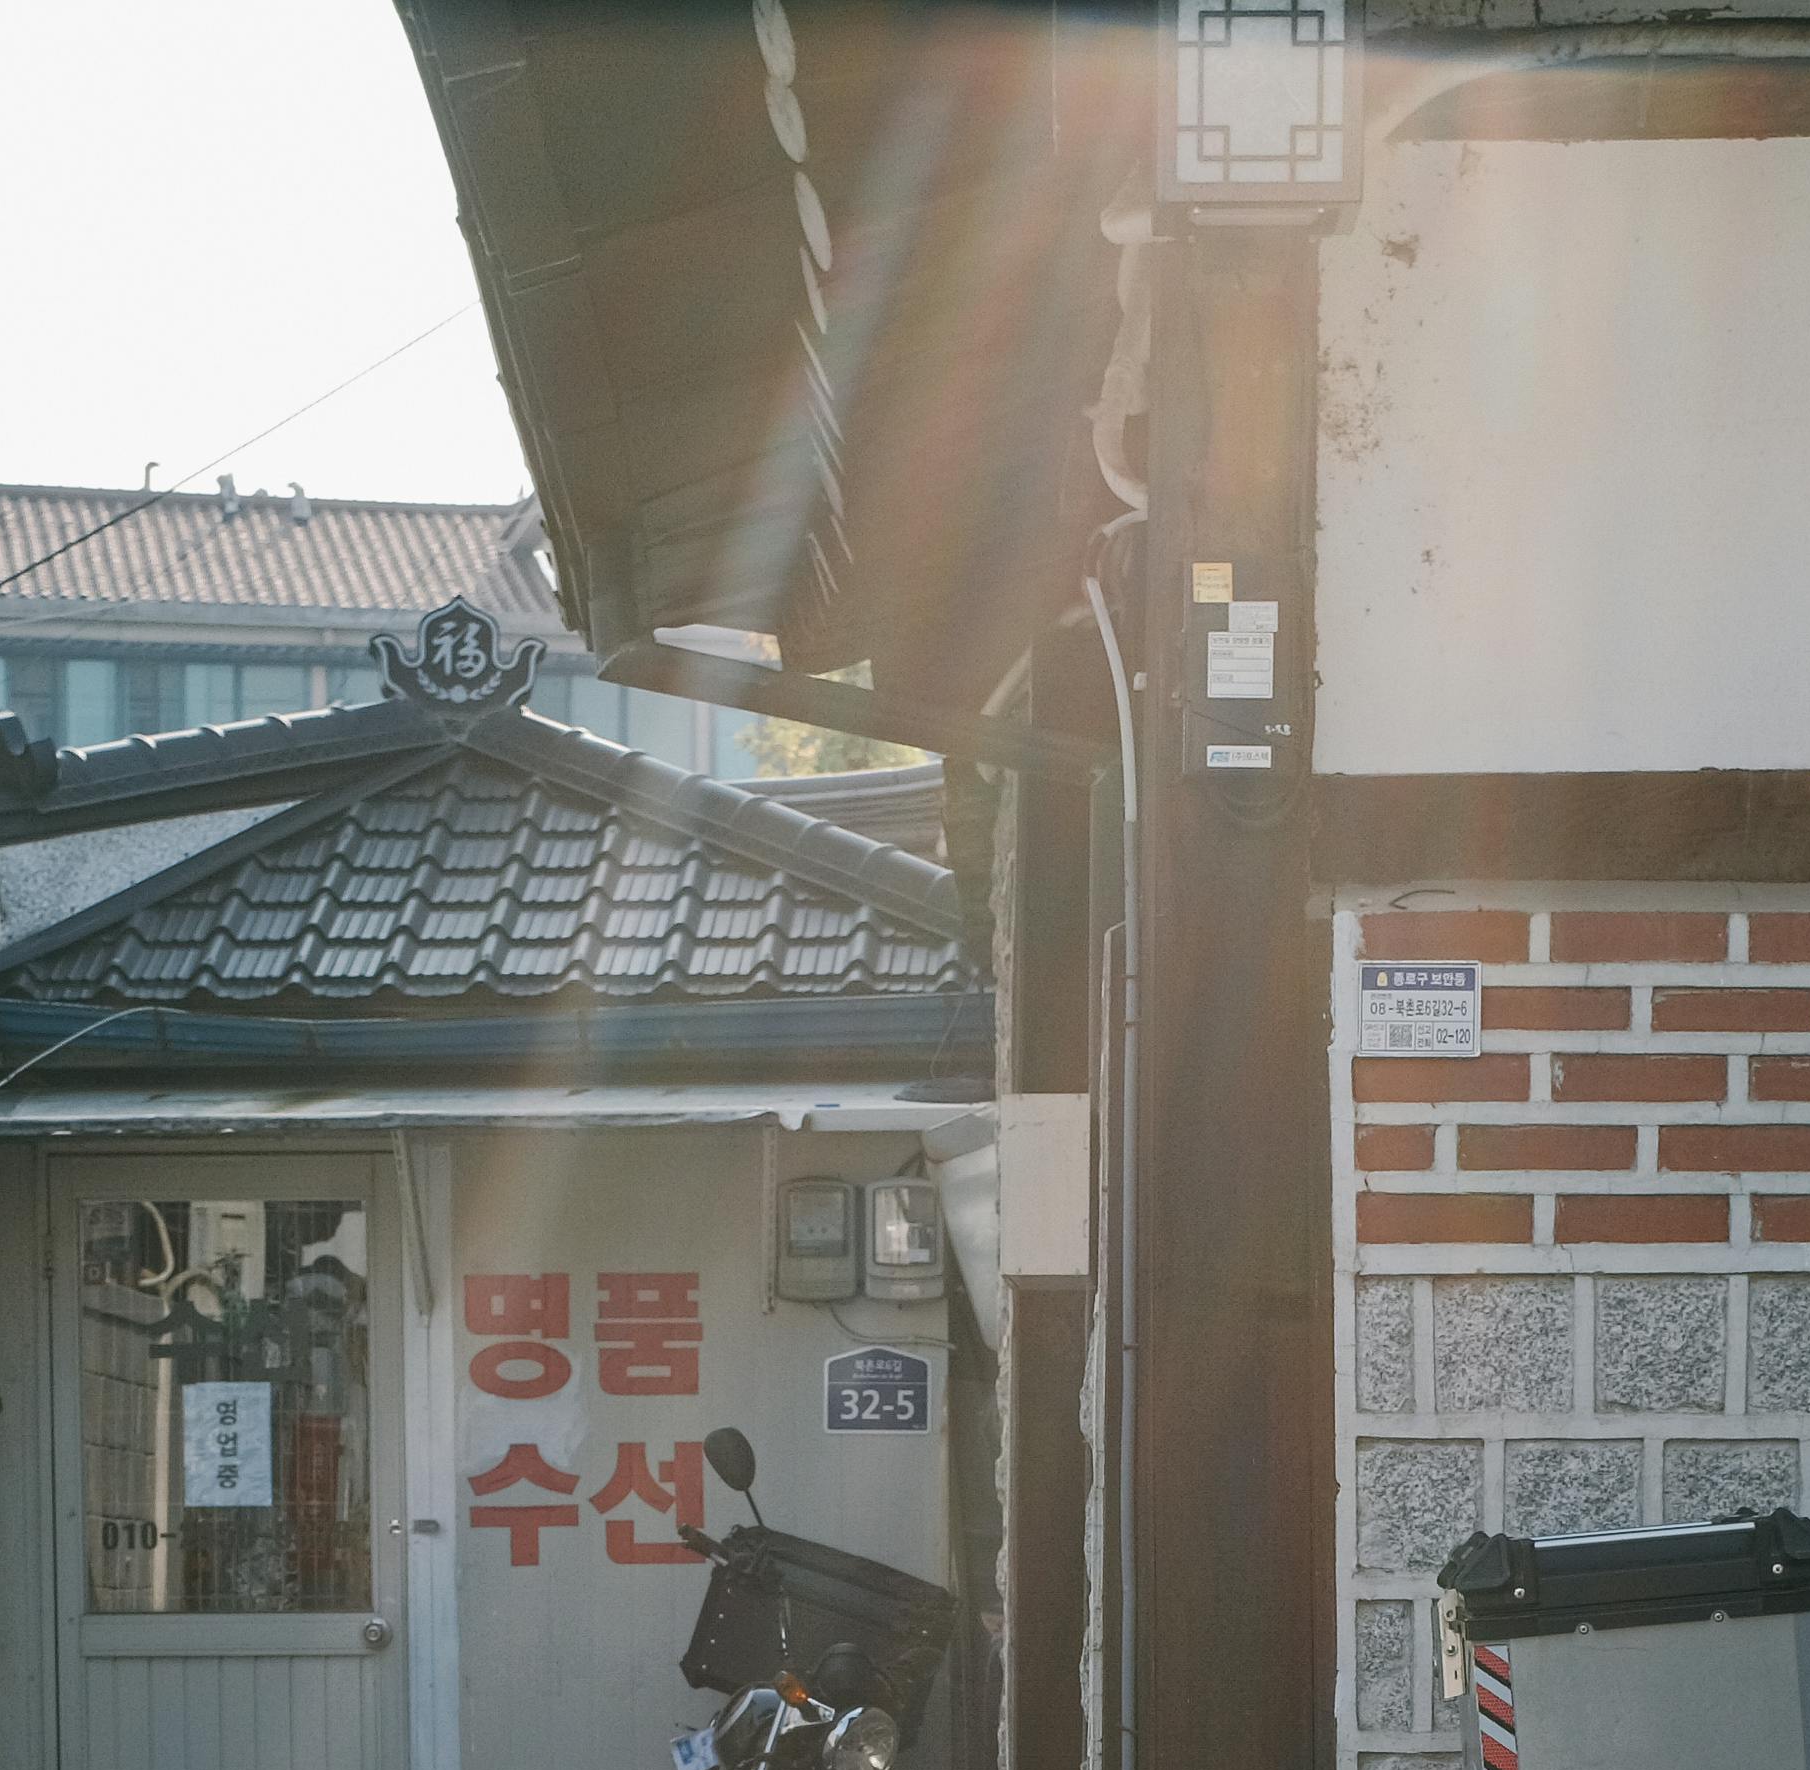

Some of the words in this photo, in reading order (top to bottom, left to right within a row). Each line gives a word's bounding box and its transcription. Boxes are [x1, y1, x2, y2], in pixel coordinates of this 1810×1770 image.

[431, 620, 487, 679] 福
[1436, 1028, 1471, 1044] 02-120
[463, 1271, 704, 1399] 명품
[839, 1388, 915, 1421] 32-5
[467, 1441, 708, 1567] 수선
